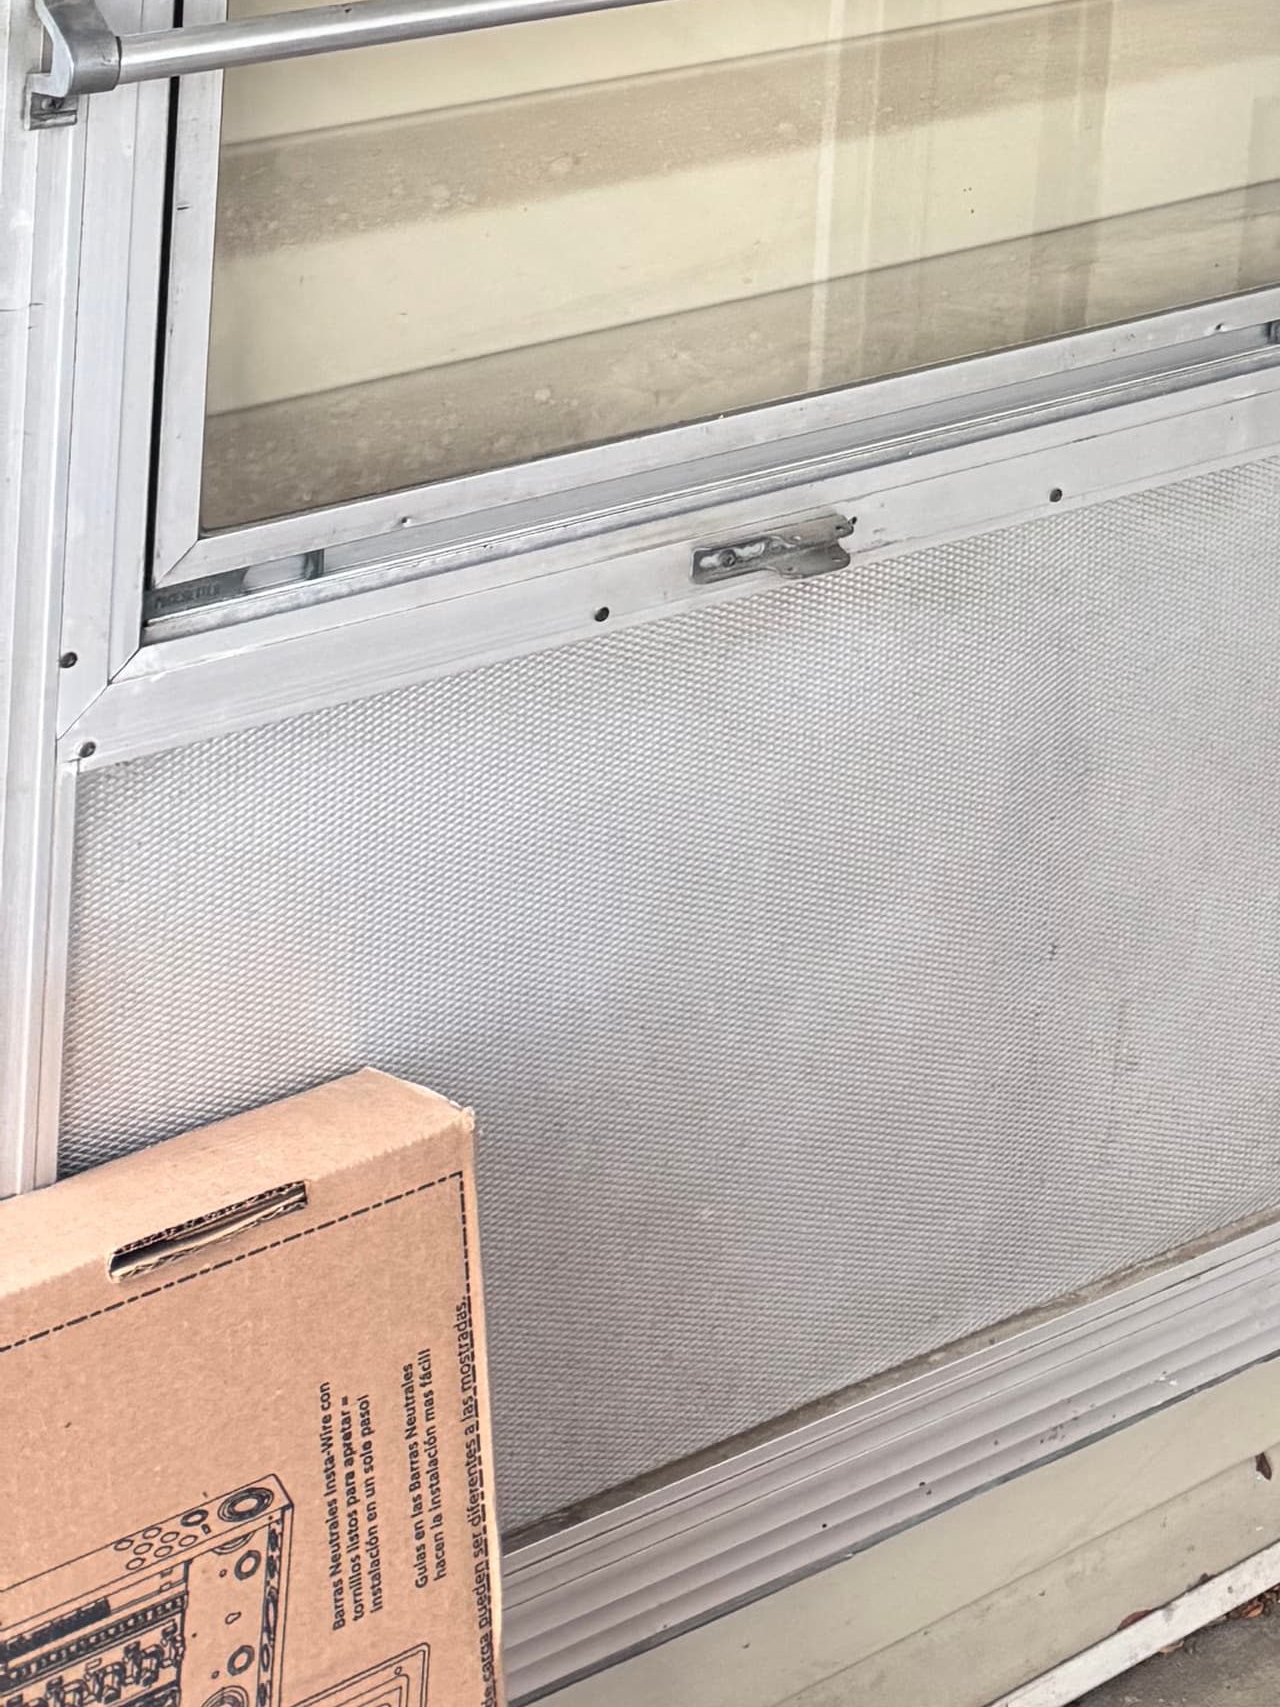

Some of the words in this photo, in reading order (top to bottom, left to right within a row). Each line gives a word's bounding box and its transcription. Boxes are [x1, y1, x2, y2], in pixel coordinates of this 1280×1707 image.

[319, 1382, 331, 1411] con
[401, 1364, 418, 1440] Neutrales
[423, 1390, 435, 1422] mas
[460, 1396, 474, 1422] las
[340, 1410, 356, 1467] apretar
[463, 1424, 475, 1435] a
[319, 1414, 337, 1496] Insta-Wire
[360, 1441, 373, 1474] solo
[408, 1442, 421, 1492] Barras
[422, 1425, 441, 1512] instalación
[344, 1471, 360, 1507] para
[363, 1477, 375, 1498] un
[465, 1439, 481, 1527] diferentes
[366, 1501, 377, 1522] en
[410, 1494, 423, 1518] las
[430, 1513, 442, 1530] la
[325, 1499, 342, 1577] Neutrales
[346, 1510, 359, 1553] listos
[413, 1520, 425, 1540] en
[472, 1532, 484, 1558] ser
[365, 1525, 383, 1613] instalación
[433, 1531, 447, 1581] hacen
[331, 1579, 346, 1630] Barras
[349, 1555, 364, 1621] tornillos
[472, 1560, 491, 1629] pueden
